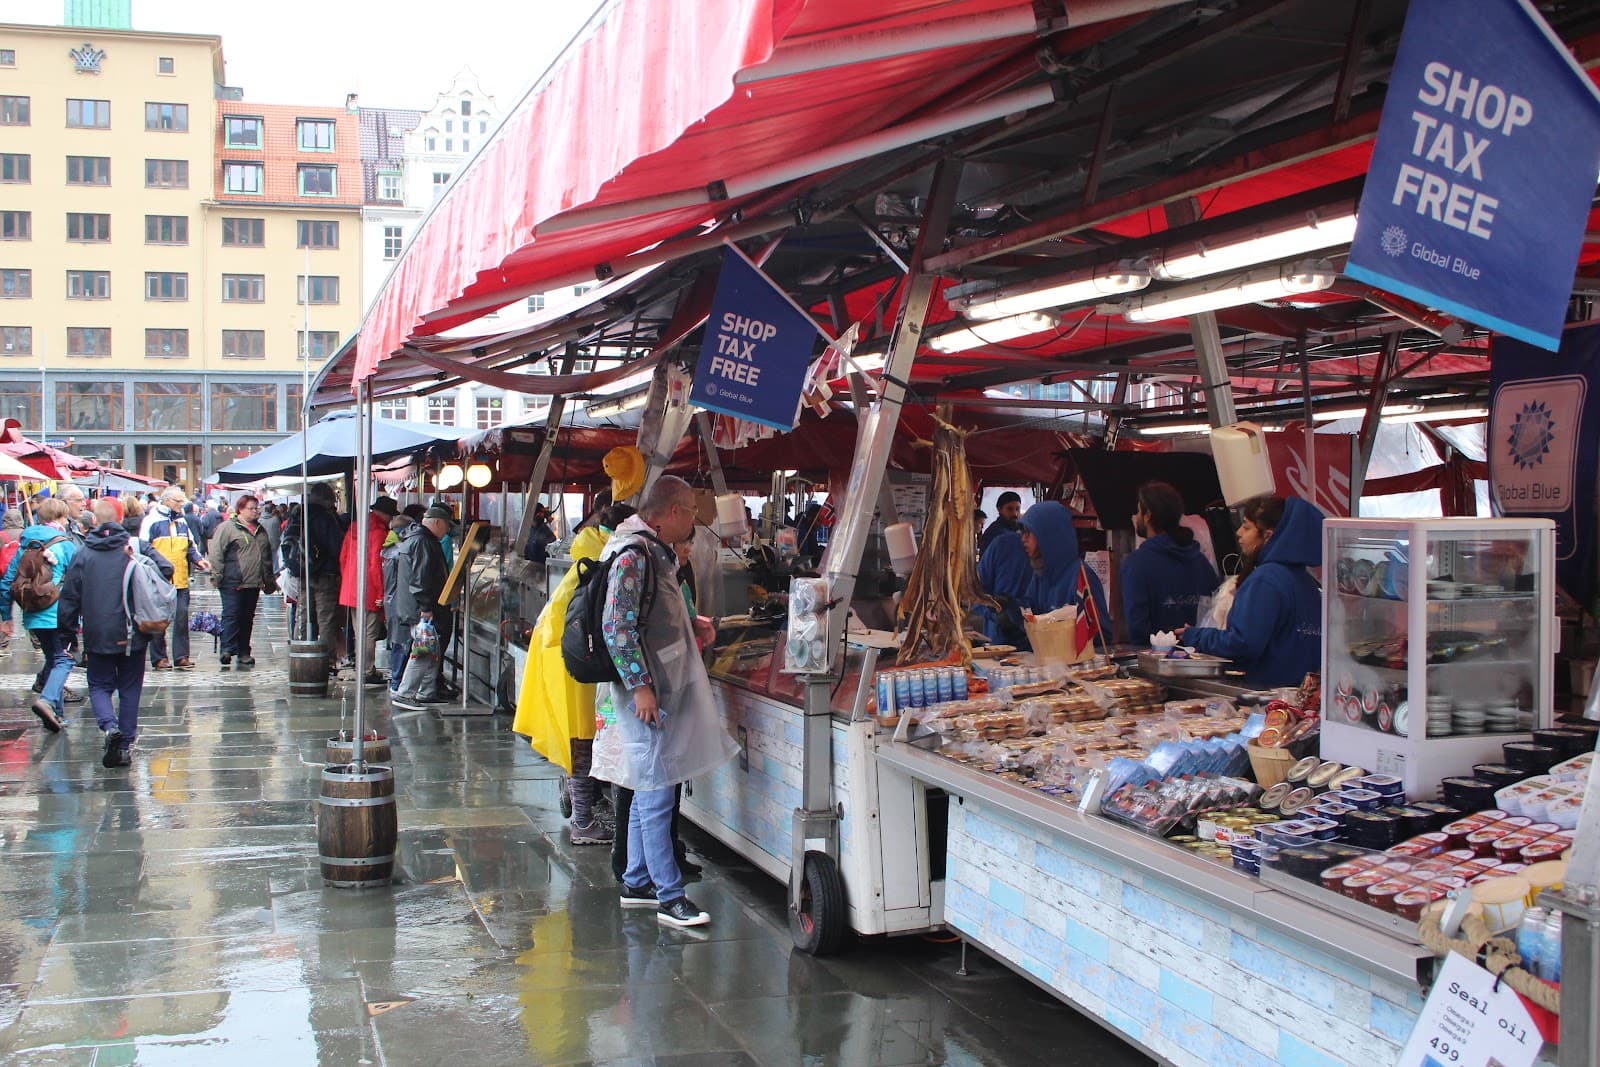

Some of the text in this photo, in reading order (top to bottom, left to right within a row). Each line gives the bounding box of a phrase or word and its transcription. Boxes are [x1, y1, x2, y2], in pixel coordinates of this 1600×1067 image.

[1418, 62, 1533, 136] SHOP
[1411, 111, 1491, 181] TAX
[1392, 163, 1499, 240] FREE
[1411, 243, 1480, 280] Global Blue
[721, 312, 777, 342] SHOP
[718, 334, 757, 362] TAX
[709, 356, 761, 387] FREE
[428, 399, 449, 407] BAR
[719, 388, 753, 405] Global Blue
[1531, 482, 1560, 500] Blue
[1448, 982, 1528, 1045] Seal oil
[1430, 1036, 1459, 1062] 499
